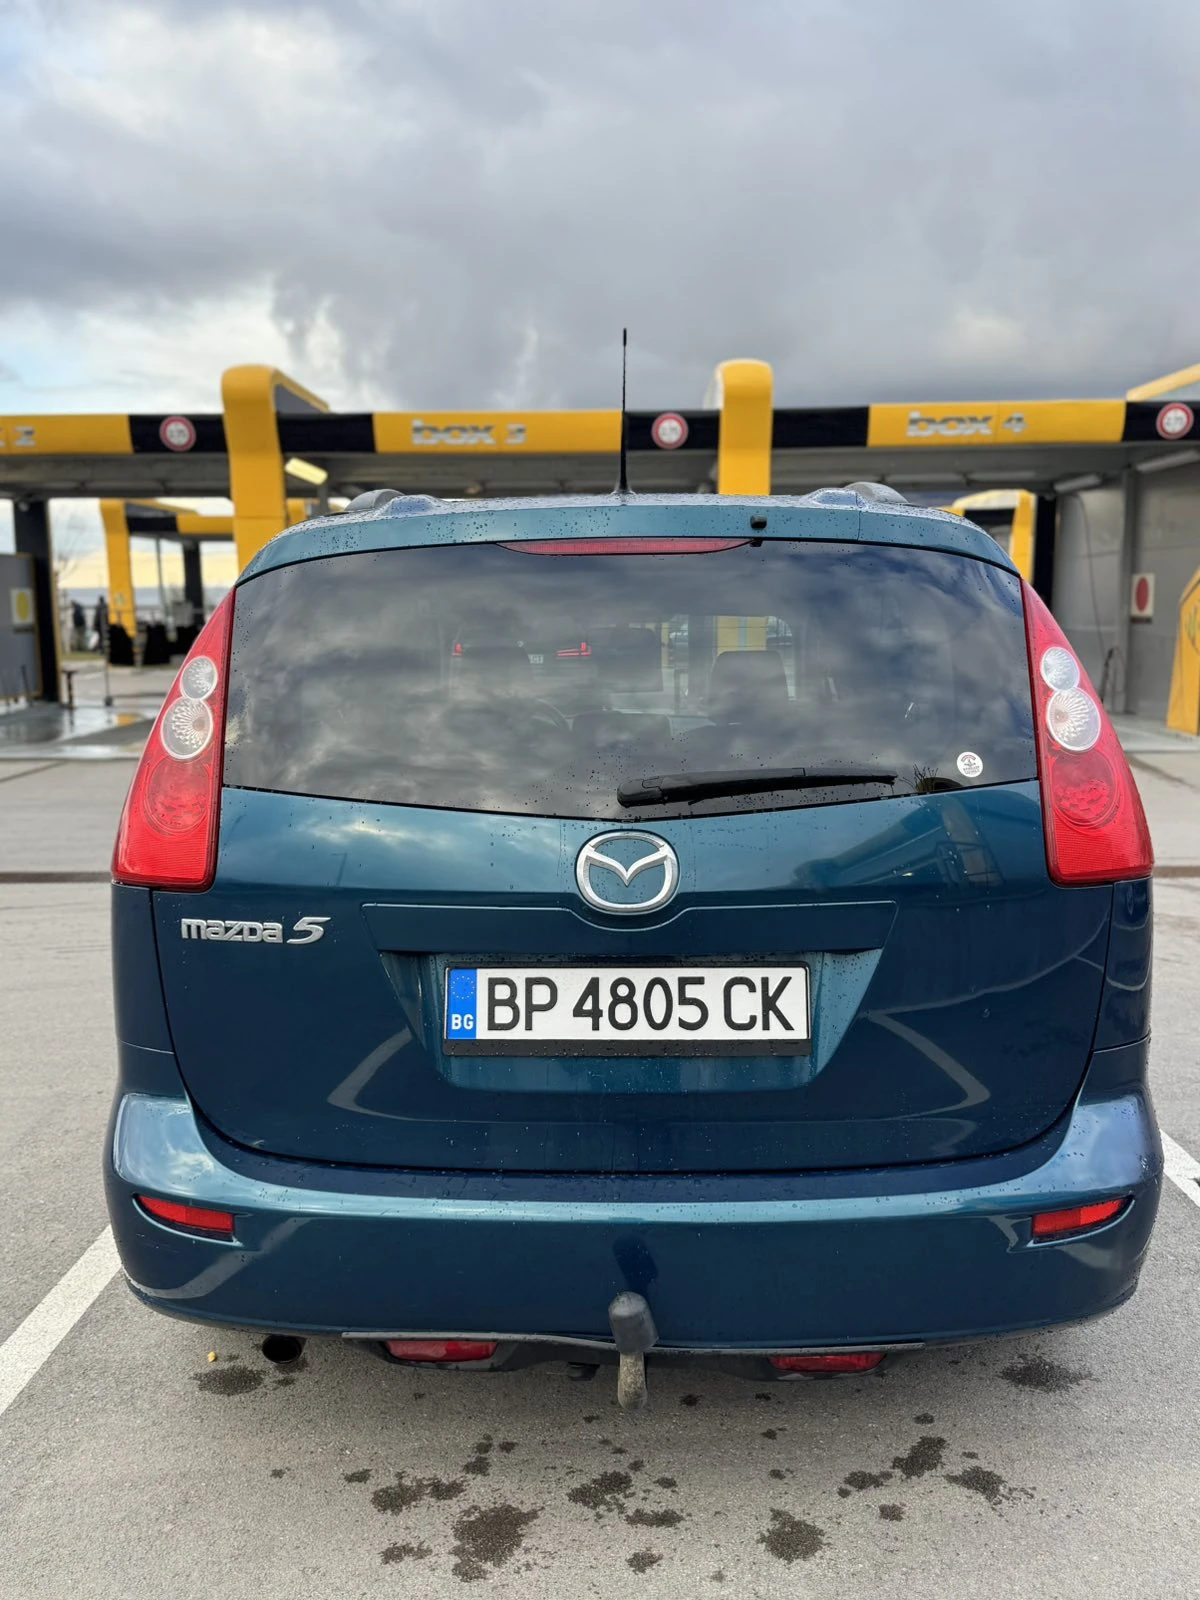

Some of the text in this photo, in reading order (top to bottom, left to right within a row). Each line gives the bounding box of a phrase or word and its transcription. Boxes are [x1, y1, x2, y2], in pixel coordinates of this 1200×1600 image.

[411, 419, 528, 446] box 3
[906, 411, 1027, 438] box 4
[286, 916, 332, 945] 5
[486, 976, 796, 1032] BP 4805 CK
[451, 1013, 475, 1031] BG
